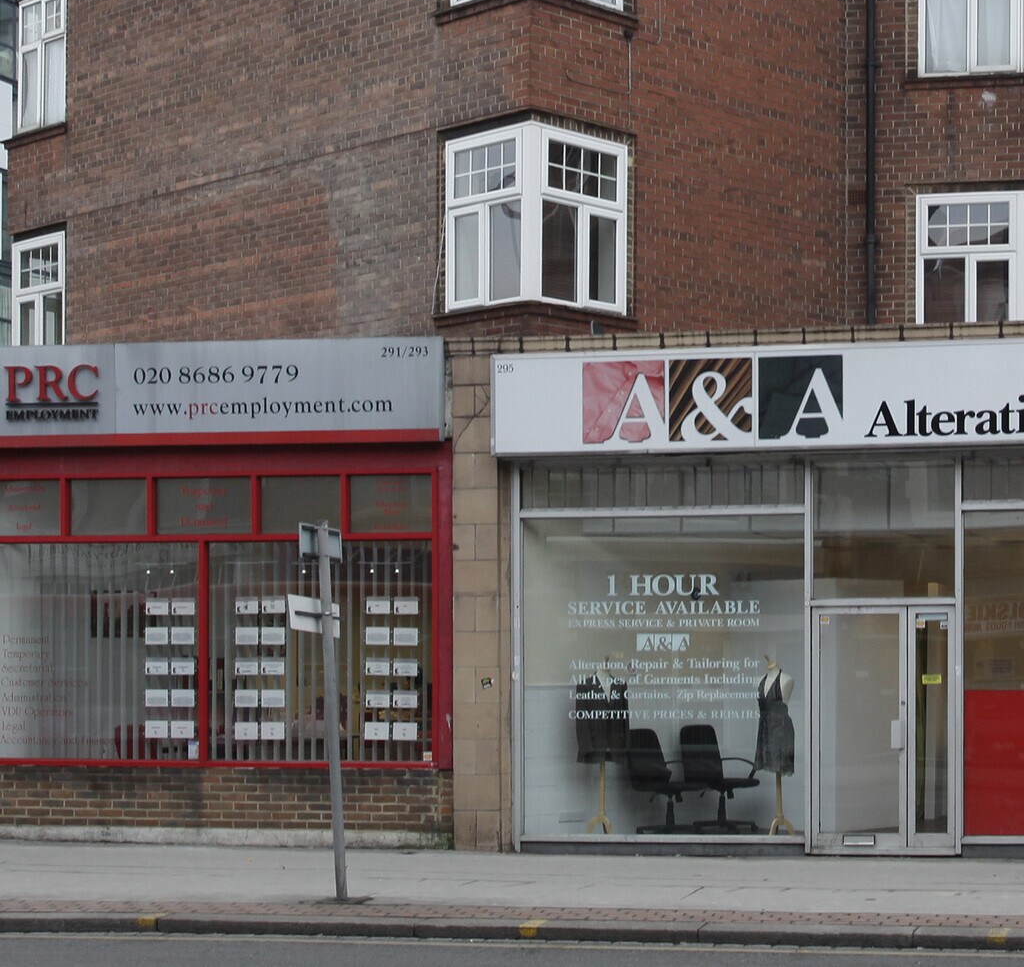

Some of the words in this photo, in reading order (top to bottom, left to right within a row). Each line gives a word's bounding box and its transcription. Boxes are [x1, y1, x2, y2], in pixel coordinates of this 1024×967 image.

[381, 346, 429, 358] 291/293
[133, 367, 172, 384] 020
[178, 366, 235, 383] 8686
[242, 365, 299, 384] 9779
[497, 364, 514, 374] 295
[3, 364, 99, 403] PRC
[133, 397, 393, 419] www.prcemployment.com
[6, 409, 99, 422] EMPLOYMENT
[607, 575, 617, 596] 1
[630, 574, 719, 597] HOUR
[568, 601, 646, 615] SERVICE
[655, 600, 760, 615] AVAILABLE
[568, 619, 615, 628] EXPRESS
[618, 619, 663, 627] SERVICE
[666, 619, 675, 627] &
[679, 619, 724, 627] PRIVATE
[727, 618, 760, 627] ROOM
[631, 658, 668, 674] Repair
[673, 659, 683, 669] &
[687, 658, 740, 671] Tailoring
[743, 657, 760, 669] for
[569, 675, 586, 684] All
[591, 674, 625, 688] Types
[628, 674, 641, 684] of
[644, 674, 700, 684] Garments
[704, 674, 760, 687] Including
[569, 690, 607, 700] Leather
[611, 690, 620, 700] &
[677, 689, 694, 702] Zip
[696, 689, 761, 702] Replacement
[568, 710, 650, 720] COMPETITIVE
[653, 710, 694, 719] PRICES
[697, 710, 707, 719] &
[711, 709, 761, 719] REPAIRS
[2, 721, 26, 733] Legal
